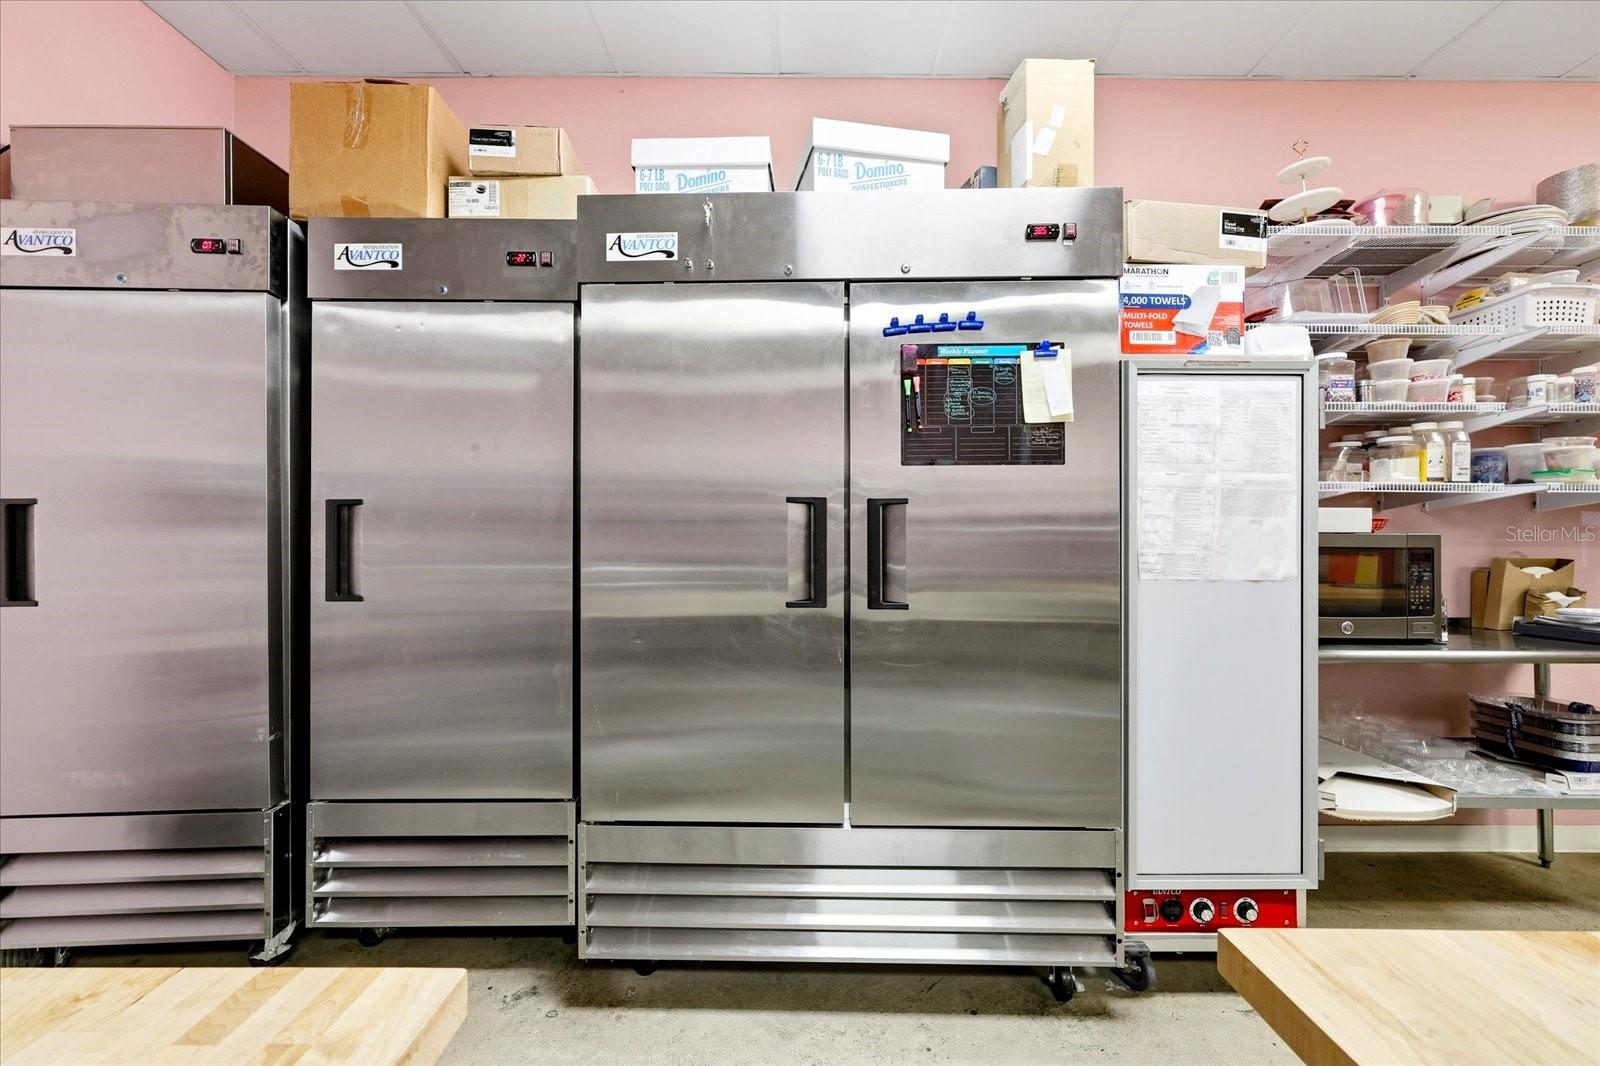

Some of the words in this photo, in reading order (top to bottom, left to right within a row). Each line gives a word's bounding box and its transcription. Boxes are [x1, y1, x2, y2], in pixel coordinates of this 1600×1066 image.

[833, 153, 844, 168] LB
[639, 168, 653, 181] 6-7
[655, 168, 665, 181] LB
[817, 166, 832, 177] POLY
[833, 168, 849, 179] BAGS
[854, 161, 905, 180] Domino
[675, 169, 727, 191] Domino
[639, 182, 654, 192] POLY
[655, 182, 671, 192] BAGS
[1123, 267, 1169, 275] MARATHON
[1123, 296, 1148, 306] 4,000
[1123, 312, 1168, 320] MULTI-FOLD
[1123, 321, 1154, 329] TOWELS
[940, 346, 962, 357] Weekly
[962, 347, 989, 355] Planner
